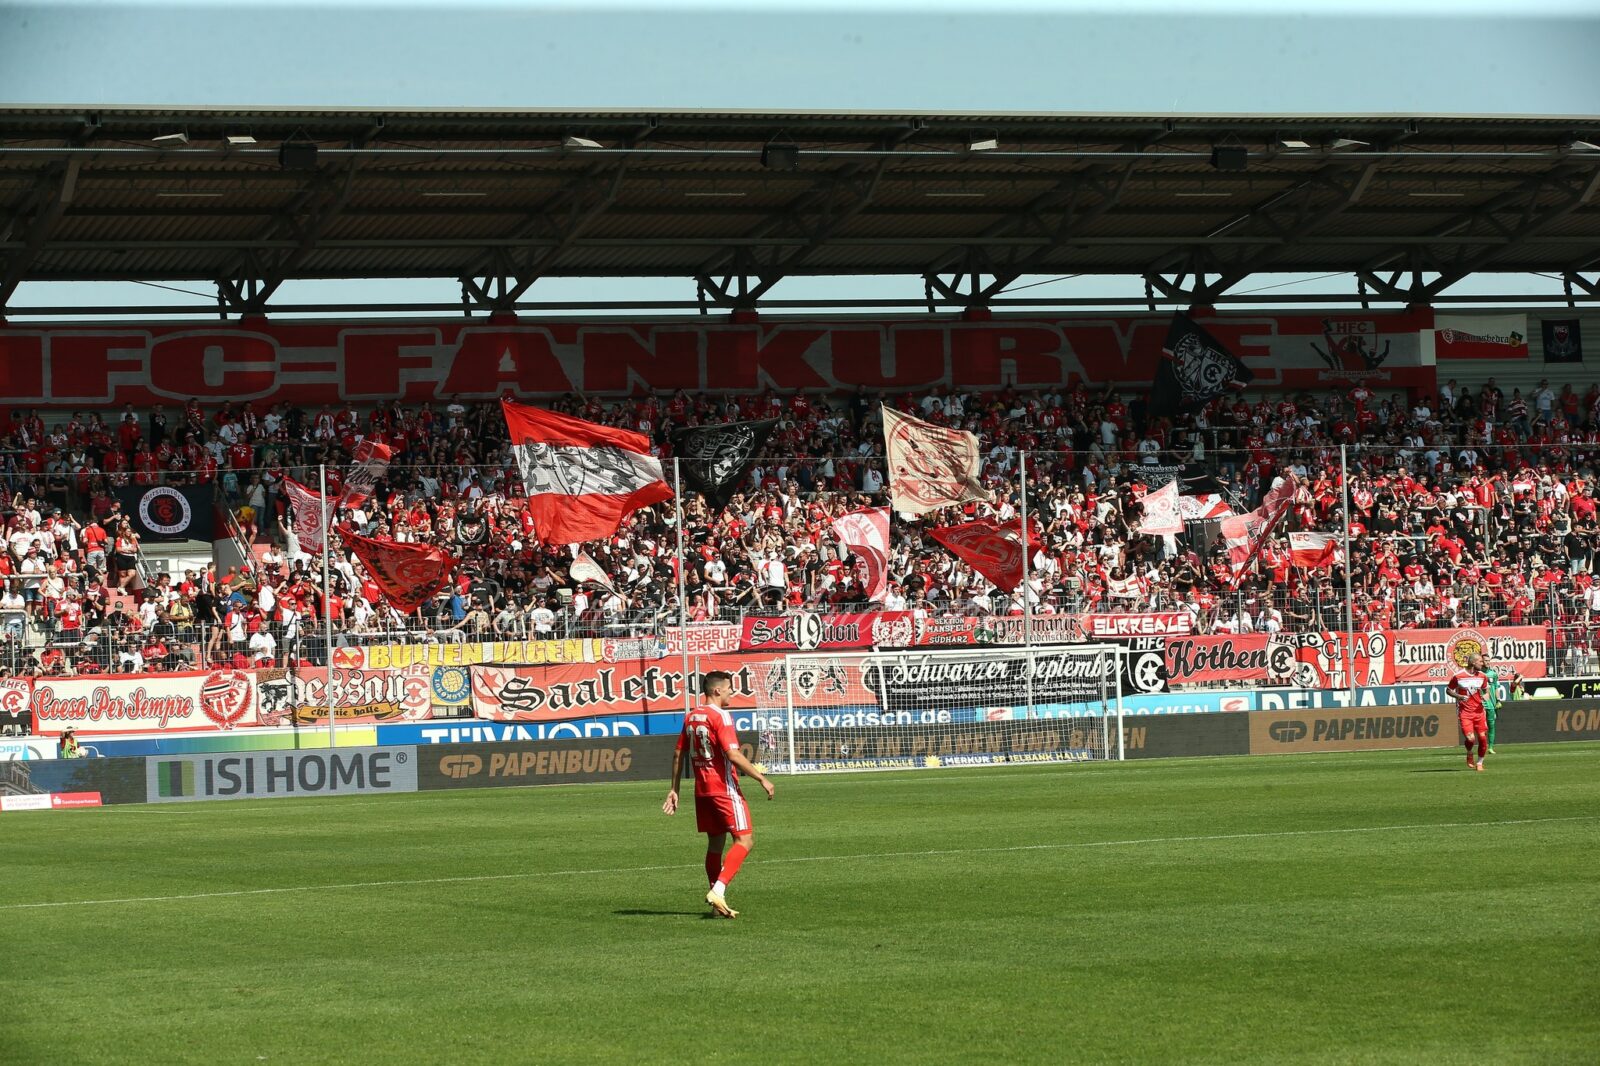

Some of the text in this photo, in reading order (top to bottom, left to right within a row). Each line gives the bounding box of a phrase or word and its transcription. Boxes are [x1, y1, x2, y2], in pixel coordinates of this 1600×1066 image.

[1336, 322, 1367, 334] HFC
[927, 624, 972, 632] MANSFELD
[1094, 615, 1190, 635] SURREALE
[1136, 637, 1166, 650] HFC
[1397, 639, 1446, 664] Leuna
[1489, 636, 1545, 661] Löwen
[1167, 639, 1268, 679] Köthen
[1429, 665, 1448, 677] seit
[6, 680, 27, 691] HFC
[33, 686, 194, 728] Coesa Per Sempre
[354, 706, 379, 715] halle
[1313, 715, 1440, 742] PAPENBURG
[488, 747, 632, 777] PAPENBURG
[772, 758, 915, 773] MEKUR SPIELBANK HALLE
[944, 757, 990, 766] MERKUR
[1056, 752, 1088, 761] HALLE
[205, 757, 254, 796] ISI
